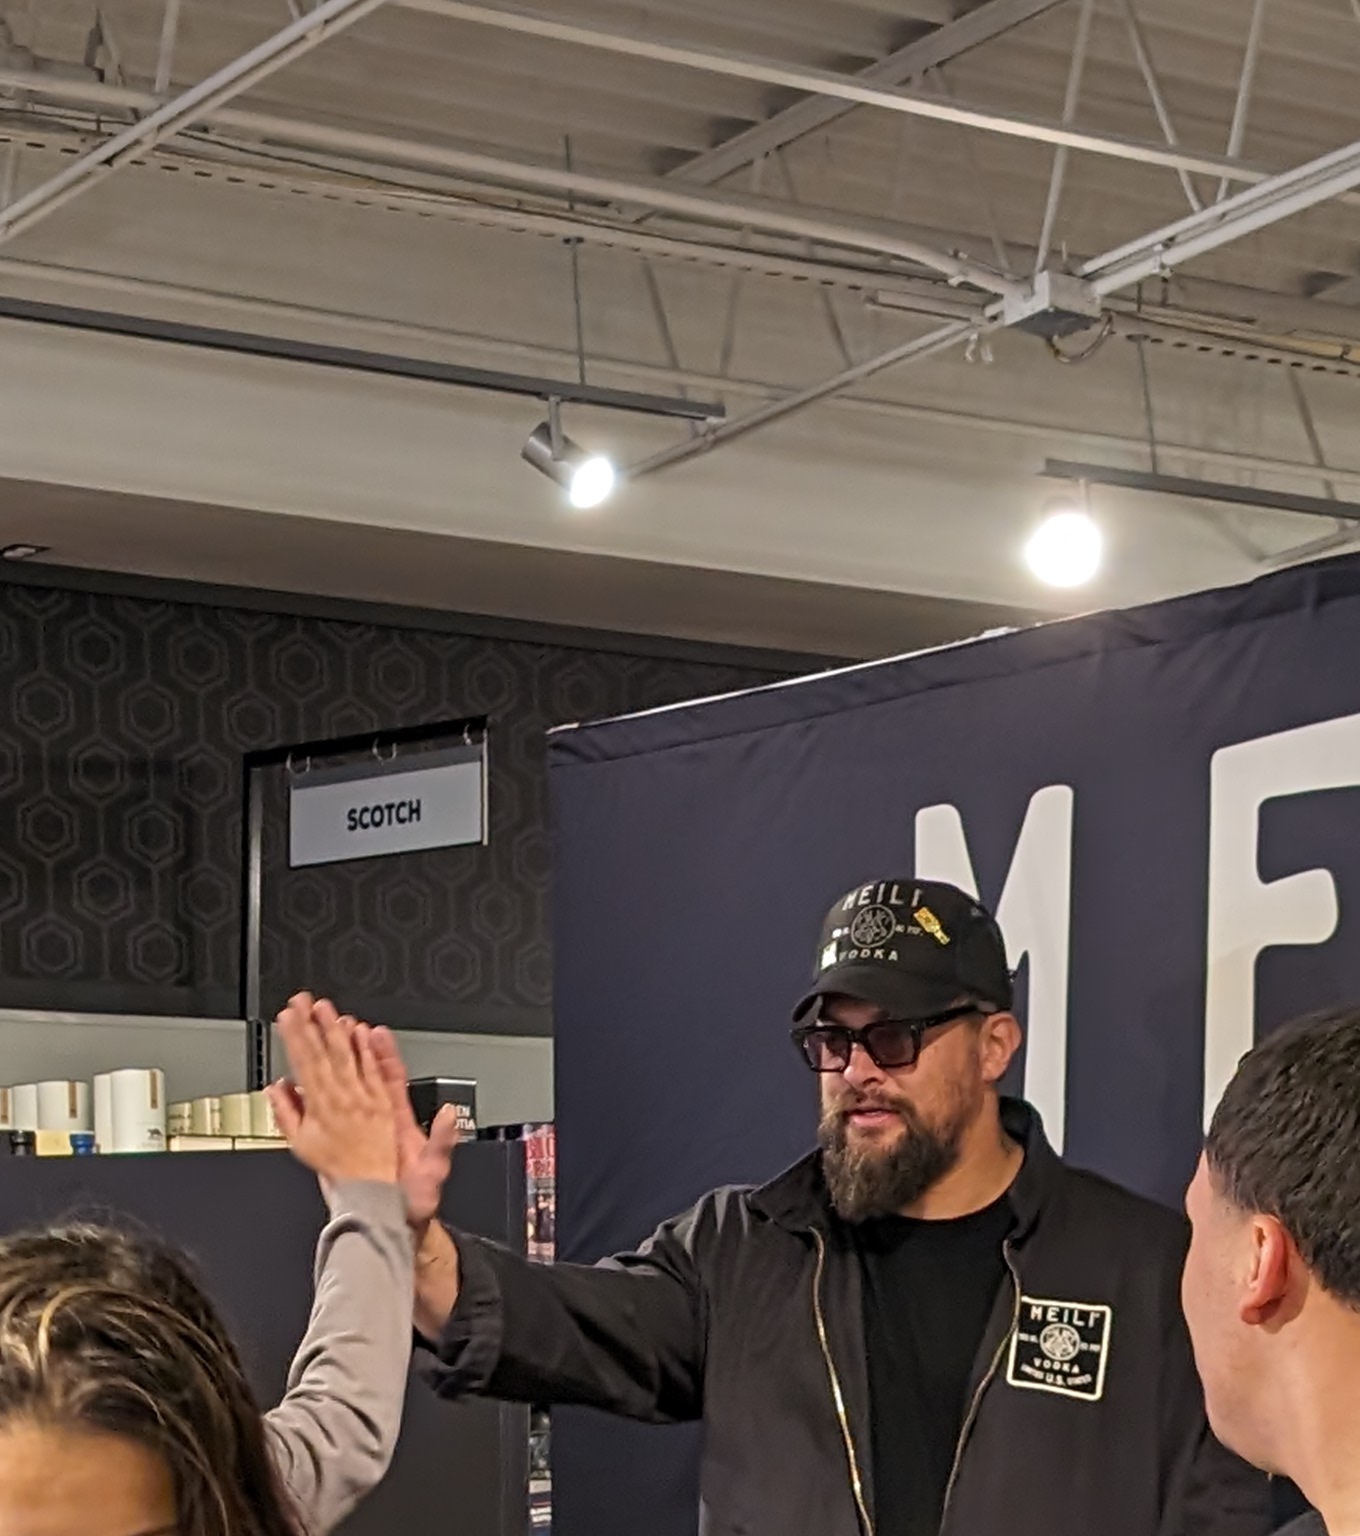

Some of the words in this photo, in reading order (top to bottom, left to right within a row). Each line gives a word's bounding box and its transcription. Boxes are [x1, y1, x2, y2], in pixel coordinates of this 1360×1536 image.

[346, 798, 422, 832] SCOTCH
[842, 883, 923, 911] MEILI
[1033, 1357, 1081, 1374] VODKA
